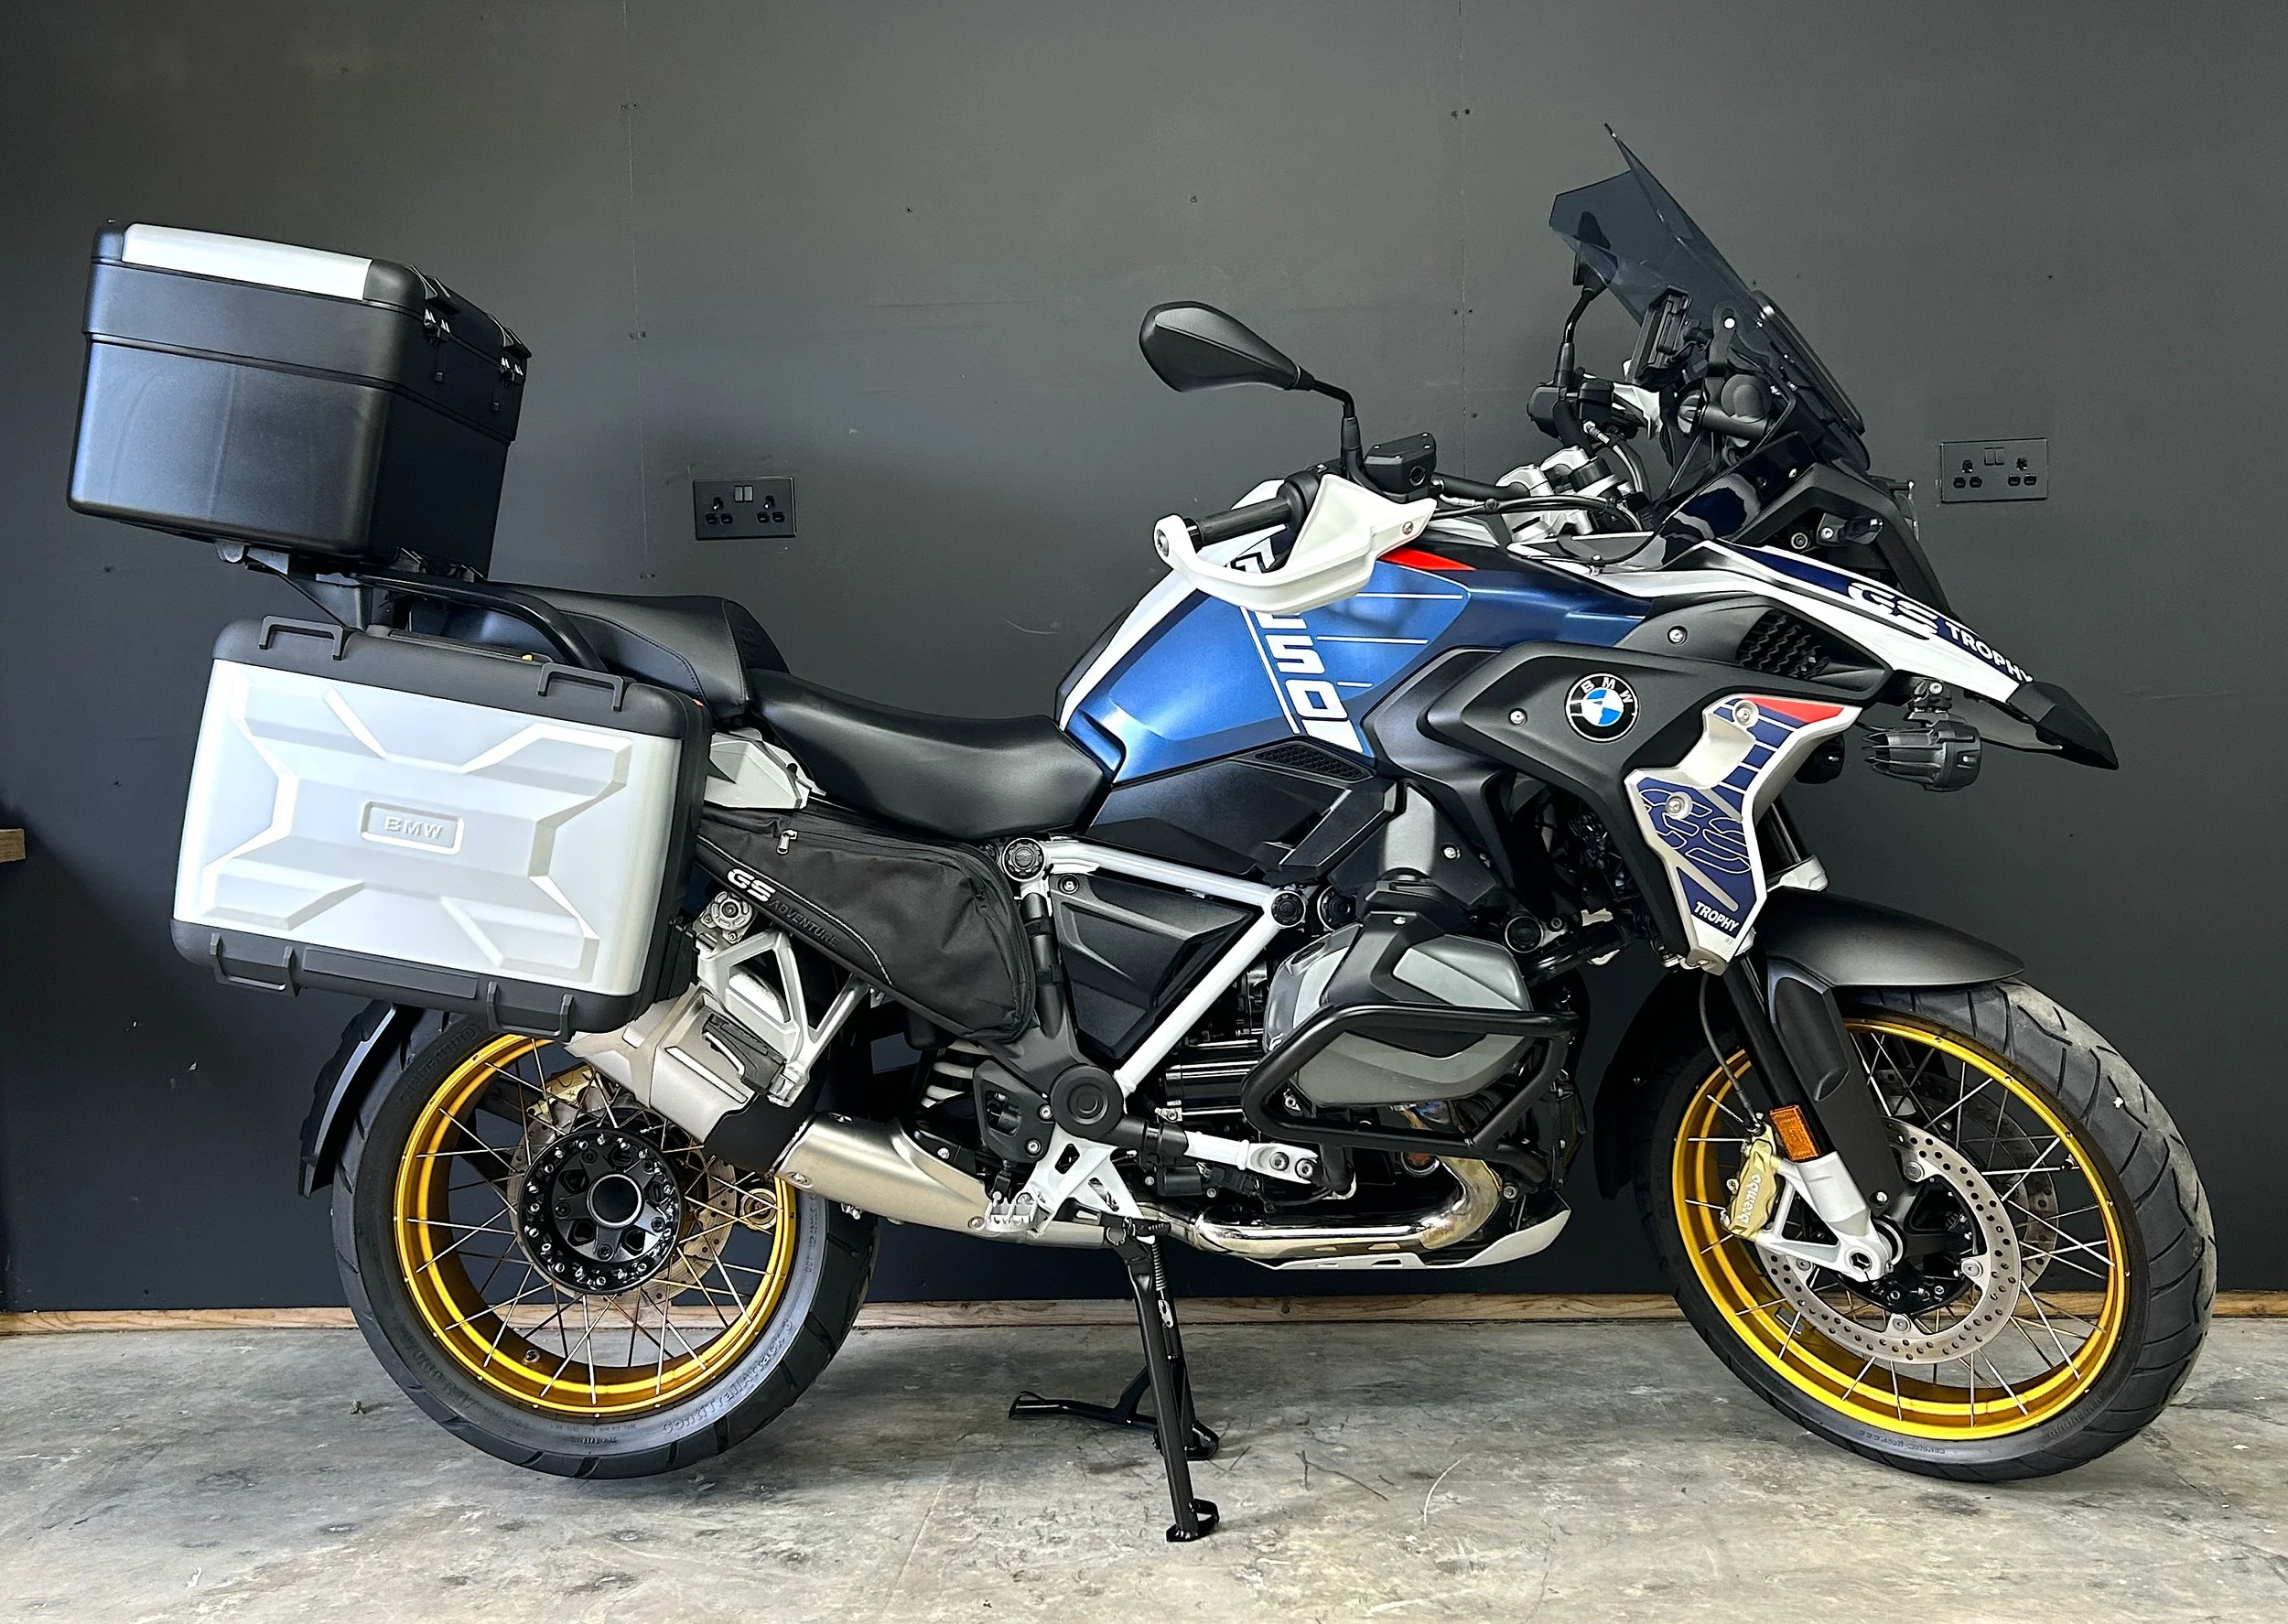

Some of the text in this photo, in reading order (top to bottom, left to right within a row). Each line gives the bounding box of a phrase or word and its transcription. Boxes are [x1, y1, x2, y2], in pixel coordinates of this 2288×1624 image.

[1580, 676, 1634, 704] BMW
[384, 815, 444, 839] BMW
[727, 868, 841, 947] GS ADVENTURE
[1693, 900, 1740, 932] TROPHY
[1737, 1174, 1762, 1224] brembo
